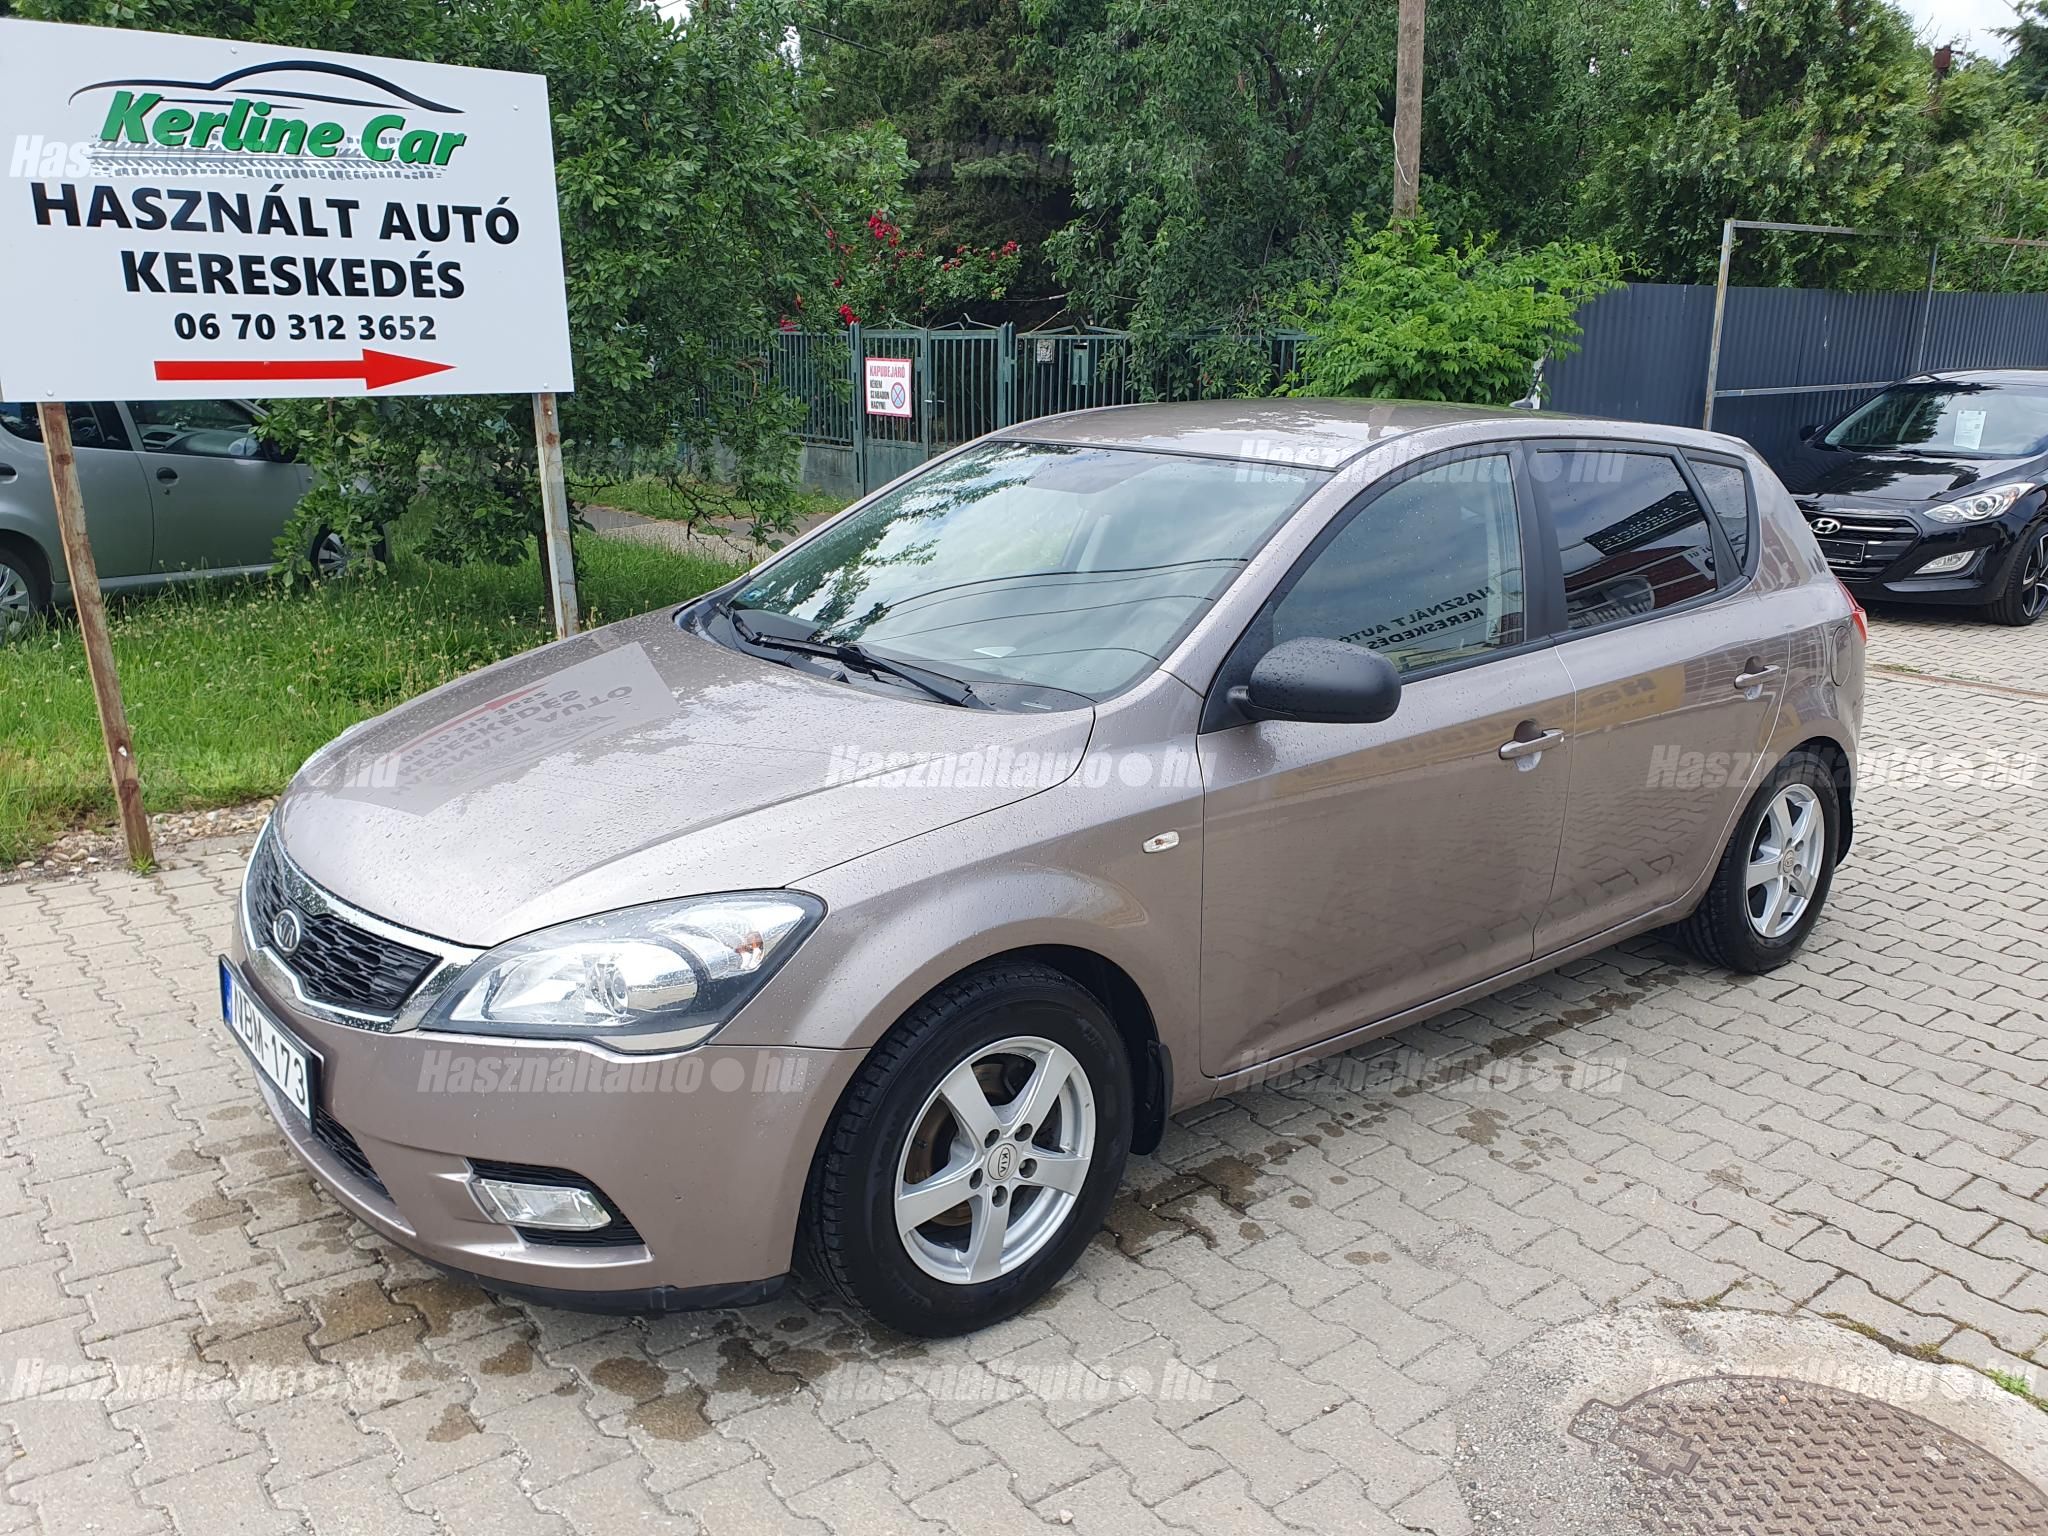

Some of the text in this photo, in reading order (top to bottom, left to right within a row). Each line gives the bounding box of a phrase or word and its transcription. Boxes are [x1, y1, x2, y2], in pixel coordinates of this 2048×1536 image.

[100, 91, 344, 157] Kerline
[361, 114, 467, 165] Car
[31, 182, 519, 244] HASZNÁLT AUTÓ
[121, 250, 465, 299] KERESKEDÉS
[174, 313, 437, 341] 06 70 312 3652
[233, 985, 306, 1106] NBM-173
